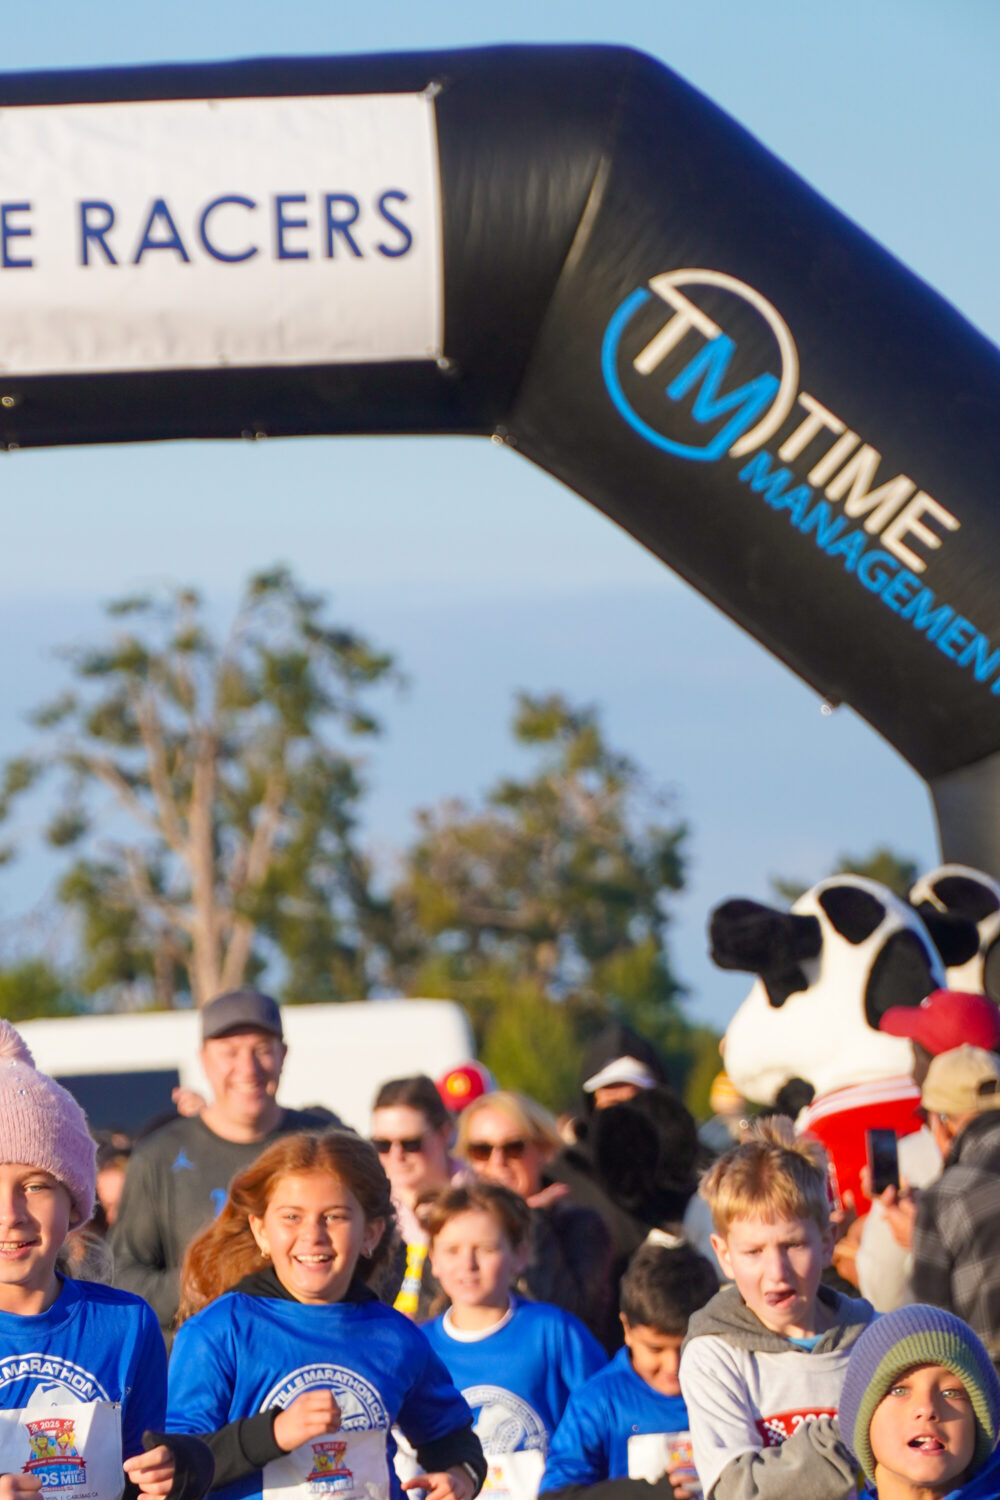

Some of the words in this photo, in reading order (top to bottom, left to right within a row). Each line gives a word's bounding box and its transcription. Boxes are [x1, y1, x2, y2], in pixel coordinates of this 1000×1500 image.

[76, 188, 415, 268] RACERS
[777, 391, 961, 573] TIME
[738, 451, 1000, 695] MANAGEMEN
[2, 1359, 96, 1401] MARATHON
[303, 1369, 376, 1406] MARATHON
[370, 1402, 387, 1428] CLU
[40, 1421, 60, 1429] 2025
